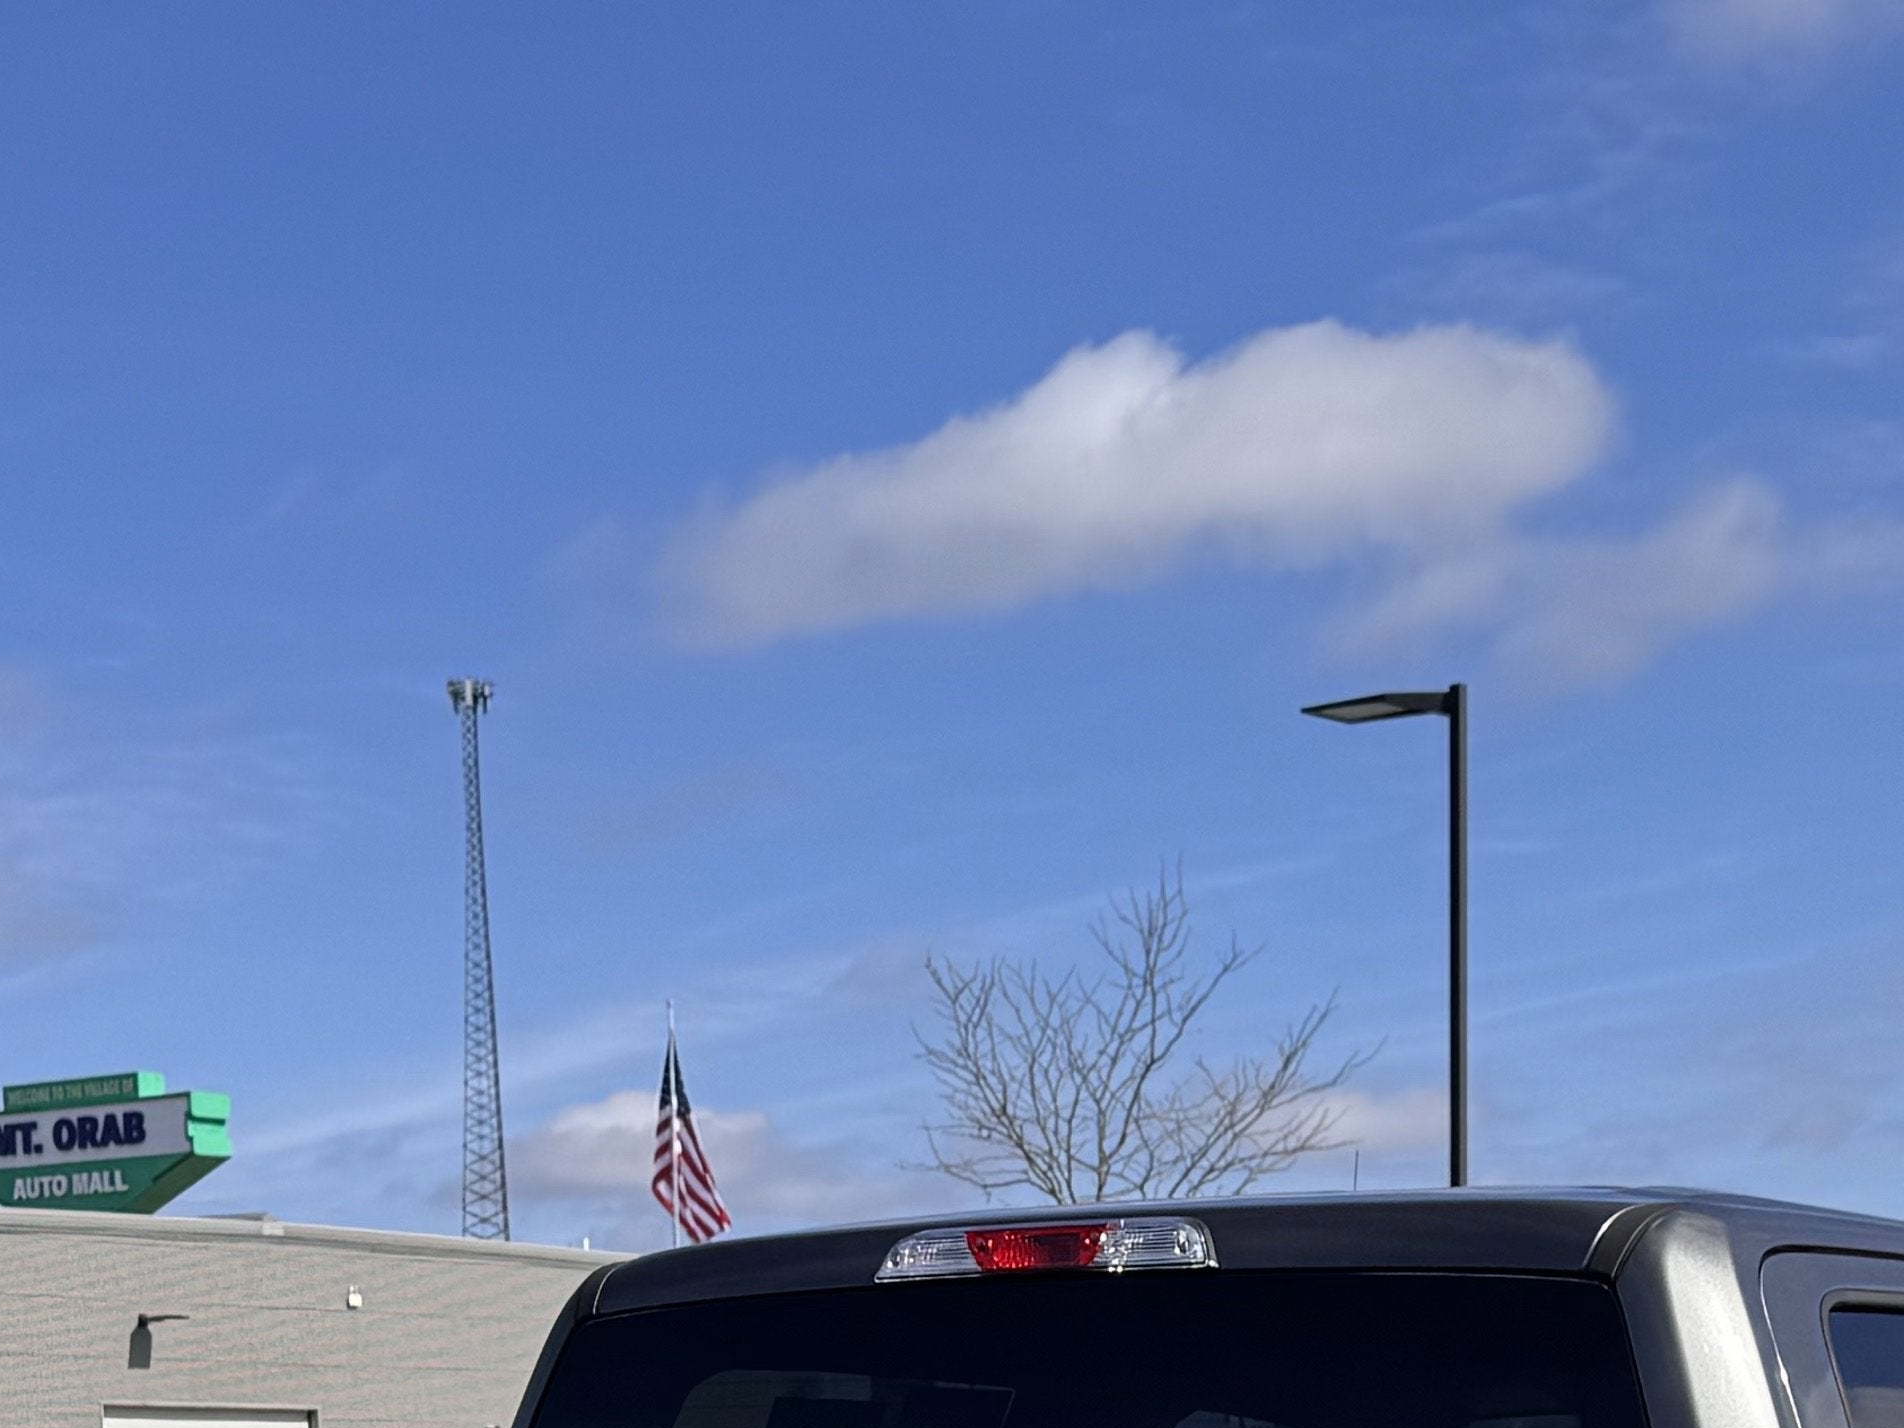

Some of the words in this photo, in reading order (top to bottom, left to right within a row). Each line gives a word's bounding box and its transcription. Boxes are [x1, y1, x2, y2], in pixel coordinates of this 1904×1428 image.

[52, 1085, 65, 1100] TO
[66, 1083, 82, 1098] THE
[84, 1079, 120, 1098] VILLAGE
[52, 1112, 146, 1151] ORAB
[13, 1174, 69, 1200] AUTO
[72, 1169, 129, 1195] MALL
